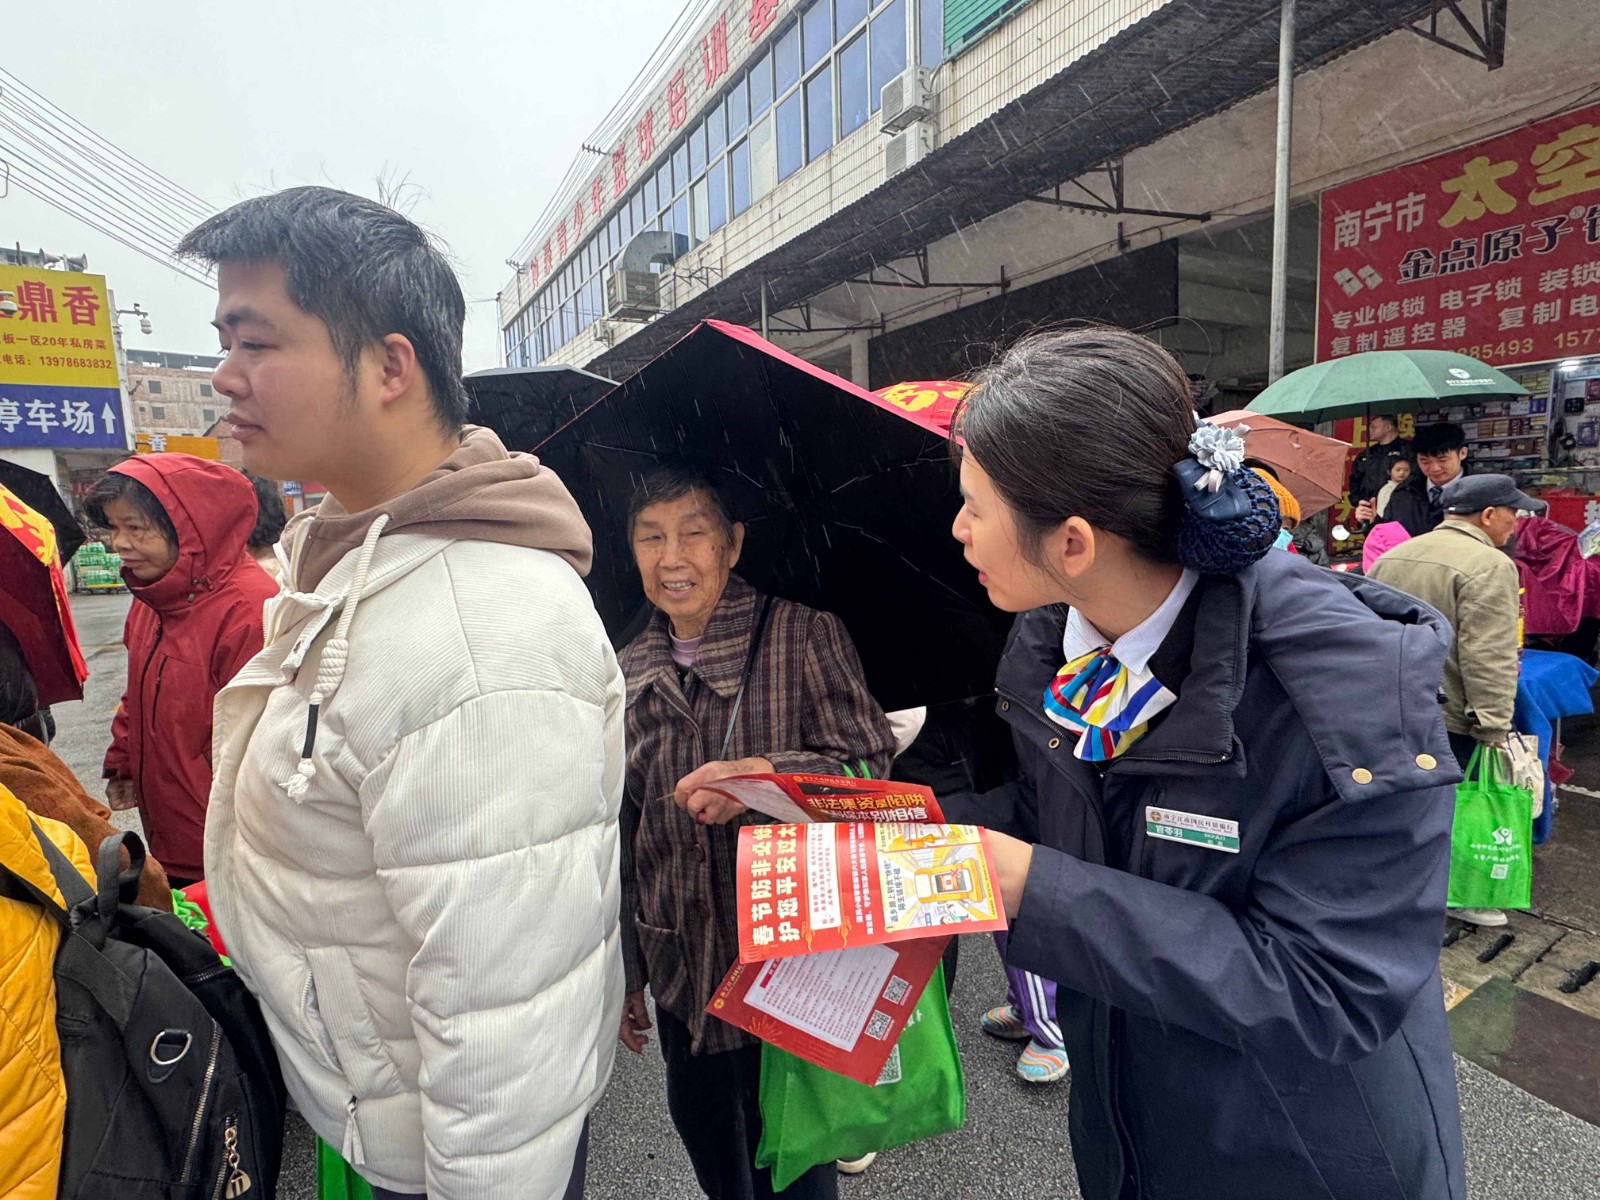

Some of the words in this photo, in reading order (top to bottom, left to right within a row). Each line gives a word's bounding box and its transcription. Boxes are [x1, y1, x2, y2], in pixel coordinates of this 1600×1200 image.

[1333, 191, 1426, 251] 南宁市
[0, 280, 100, 326] 鼎香
[1331, 296, 1425, 331] 专业修锁
[1439, 277, 1522, 310] 电子锁
[1539, 260, 1600, 293] 装锁
[0, 332, 107, 350] 板一区20年私房菜
[1330, 316, 1467, 357] 复制遥控器
[1498, 294, 1599, 331] 复制电
[0, 353, 32, 366] 电话：
[39, 355, 113, 370] 13978683832
[1448, 337, 1534, 362] 85493
[0, 398, 96, 434] 停车场
[148, 435, 167, 452] 香
[806, 793, 927, 810] 非法集资是陷阱
[824, 806, 928, 823] 利保本别相信
[751, 823, 775, 946] 春节防非必修
[776, 823, 800, 943] 护您平安过大
